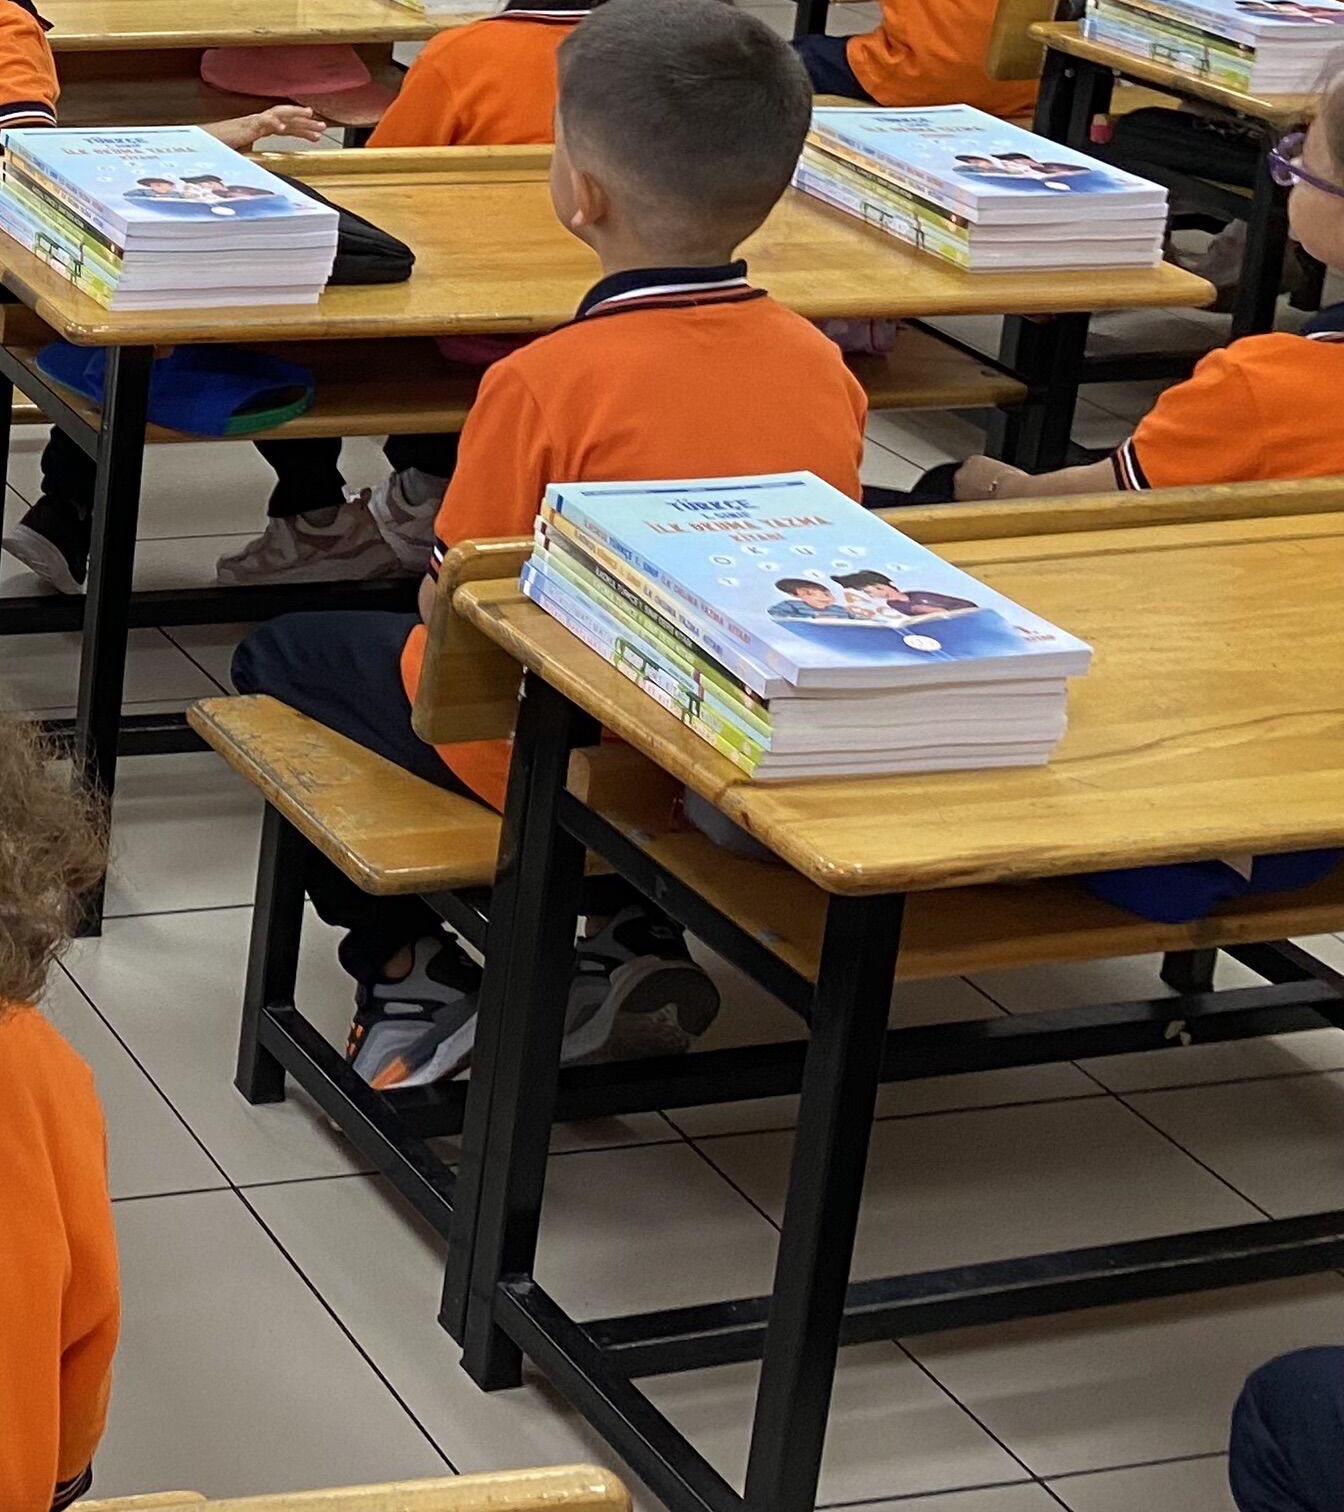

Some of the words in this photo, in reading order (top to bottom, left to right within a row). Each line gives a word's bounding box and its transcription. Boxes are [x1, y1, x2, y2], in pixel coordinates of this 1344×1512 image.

[668, 497, 761, 511] TÜRKÇE
[689, 519, 761, 532] OKUMA
[757, 516, 834, 529] YAZMA
